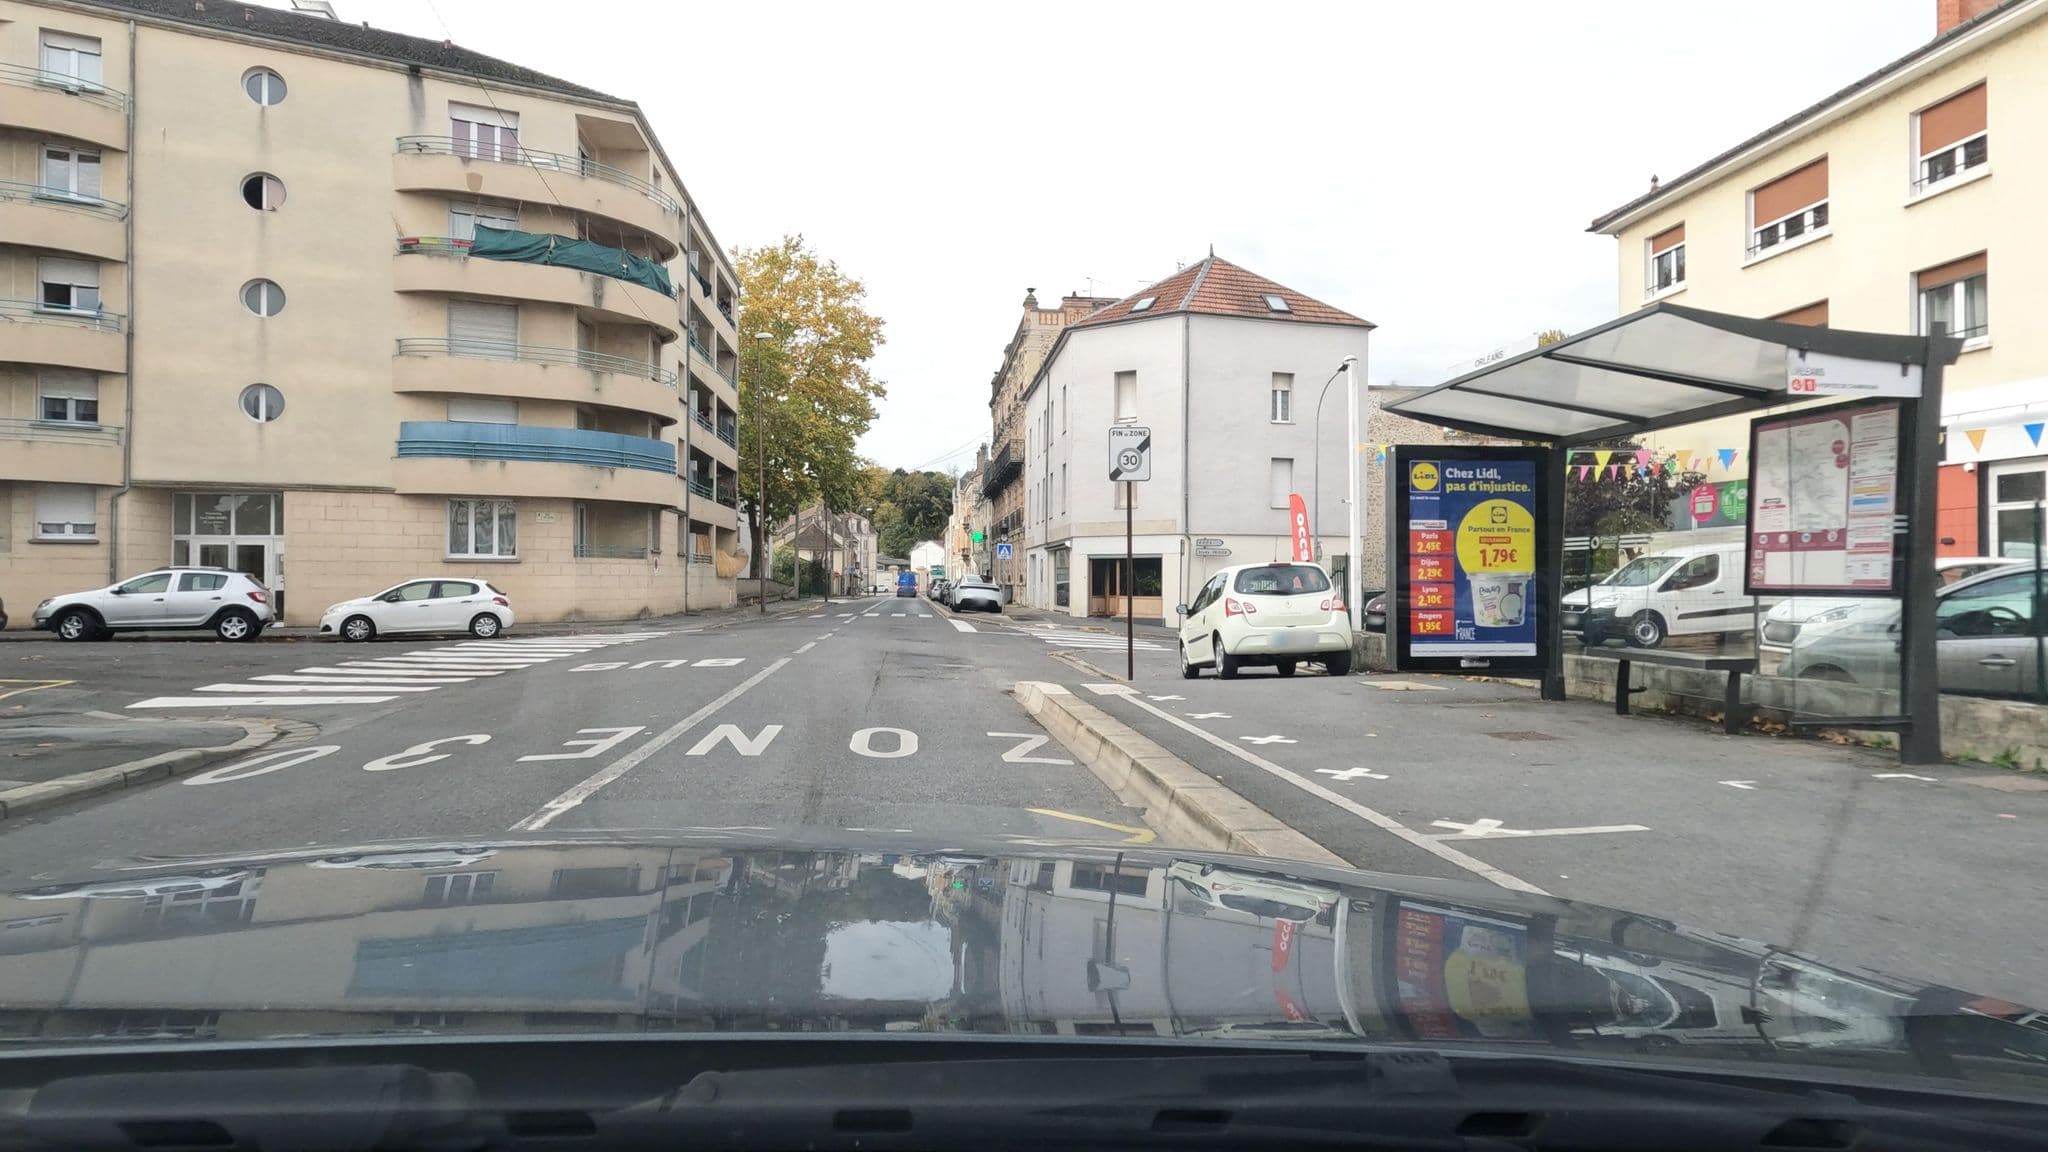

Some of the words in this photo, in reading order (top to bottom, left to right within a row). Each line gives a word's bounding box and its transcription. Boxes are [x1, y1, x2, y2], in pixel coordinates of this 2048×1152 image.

[1123, 455, 1137, 465] 30
[1445, 468, 1474, 479] Chez
[1476, 468, 1501, 480] Lidl,
[1446, 483, 1466, 493] pas
[1469, 481, 1531, 494] d'injustice.
[1417, 542, 1442, 553] 2.45€
[1421, 559, 1440, 567] Dijon
[1480, 549, 1517, 567] 1.79€
[1422, 586, 1438, 594] Lyon
[1418, 595, 1442, 606] 2.10€
[1418, 621, 1442, 632] 1.95€
[568, 658, 746, 671] BUS
[515, 724, 1075, 766] ZONE
[182, 734, 492, 785] 30
